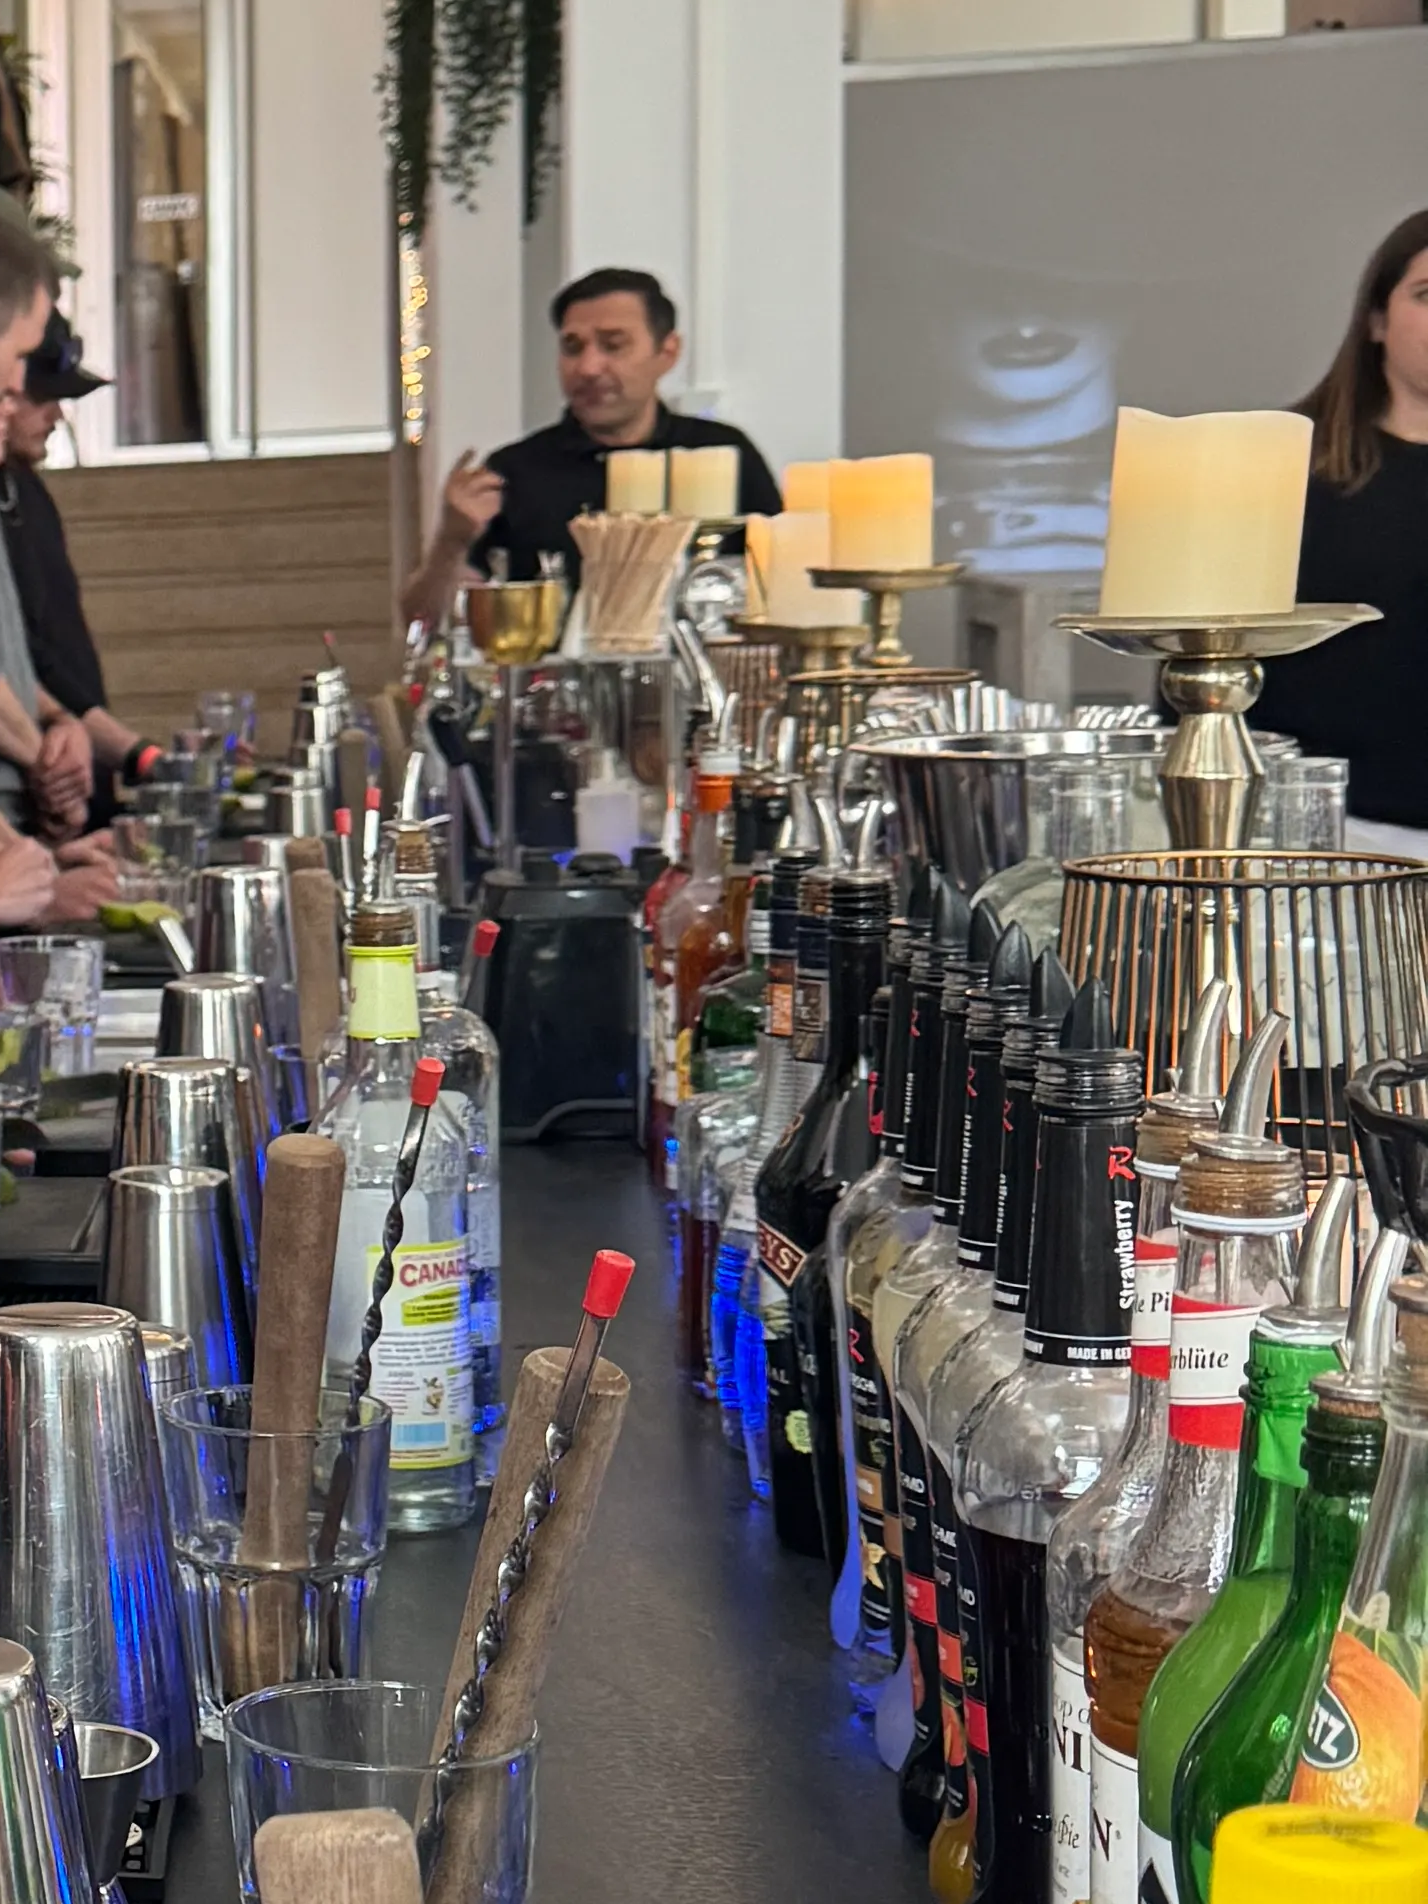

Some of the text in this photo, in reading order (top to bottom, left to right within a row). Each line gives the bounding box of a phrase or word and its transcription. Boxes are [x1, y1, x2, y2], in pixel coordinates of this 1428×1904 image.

[1113, 1199, 1136, 1310] Strawberry
[1066, 1346, 1099, 1360] MADE
[1100, 1347, 1113, 1360] IN
